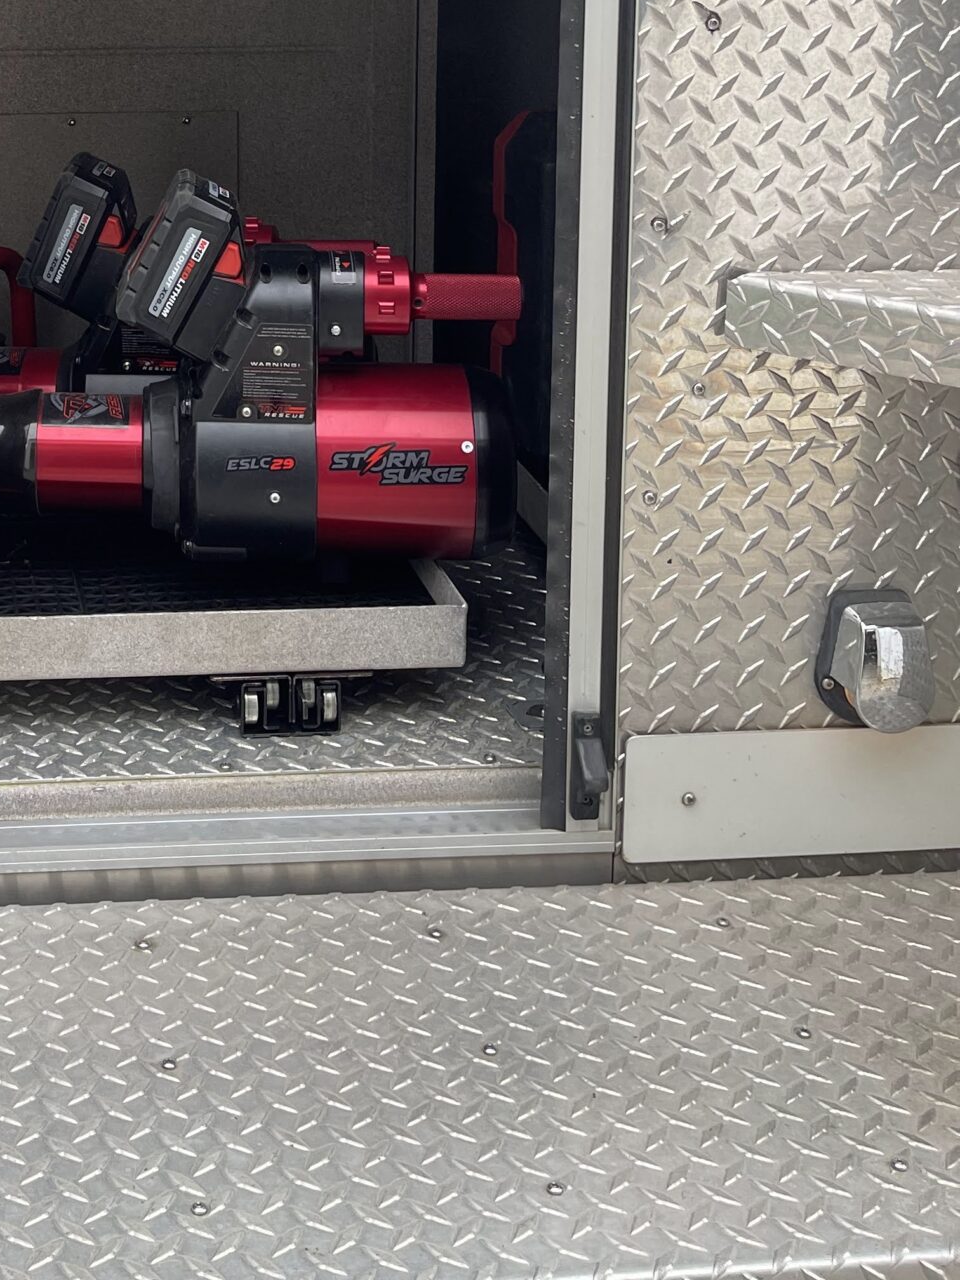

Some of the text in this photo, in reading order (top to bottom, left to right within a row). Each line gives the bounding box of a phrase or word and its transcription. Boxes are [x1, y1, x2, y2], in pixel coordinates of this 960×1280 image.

[183, 233, 197, 256] HIGH
[193, 239, 208, 261] M18
[165, 256, 185, 289] OUTPUT
[227, 456, 295, 471] ESLC29
[331, 445, 430, 473] STORM
[380, 467, 468, 484] SURGE
